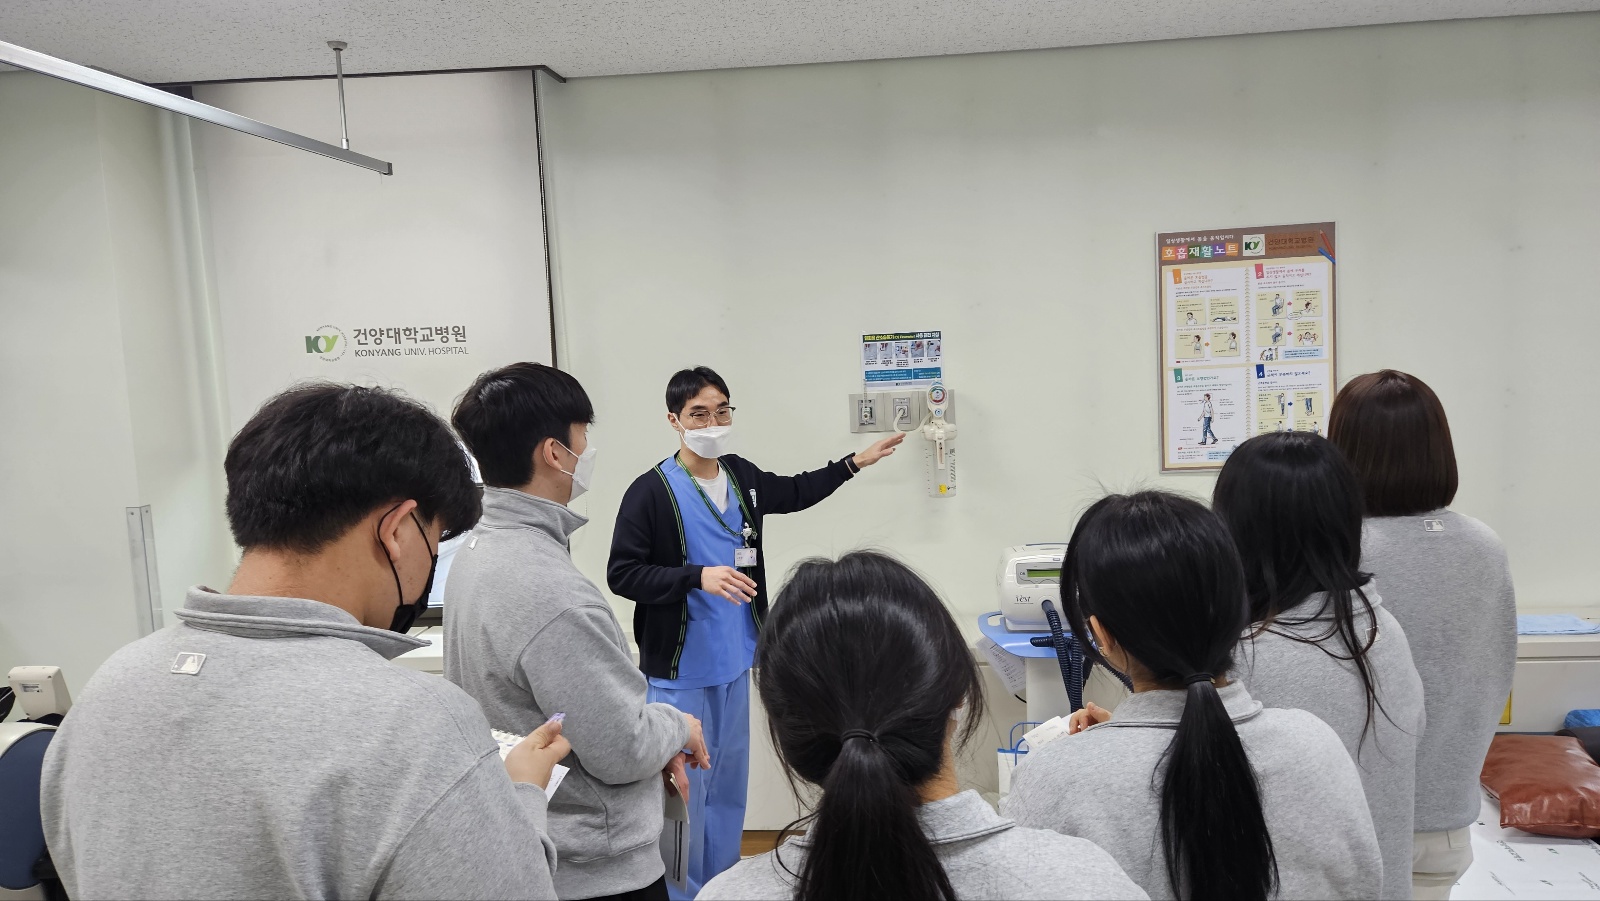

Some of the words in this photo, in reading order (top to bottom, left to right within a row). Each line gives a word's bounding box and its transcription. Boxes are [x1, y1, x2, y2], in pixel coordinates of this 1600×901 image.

[1163, 244, 1238, 260] 호흡재활노트
[353, 325, 467, 346] 건양대학교병원
[305, 335, 339, 354] KY
[354, 348, 401, 358] KONYANG
[404, 347, 427, 356] UNIV.
[428, 346, 469, 356] HOSPITAL
